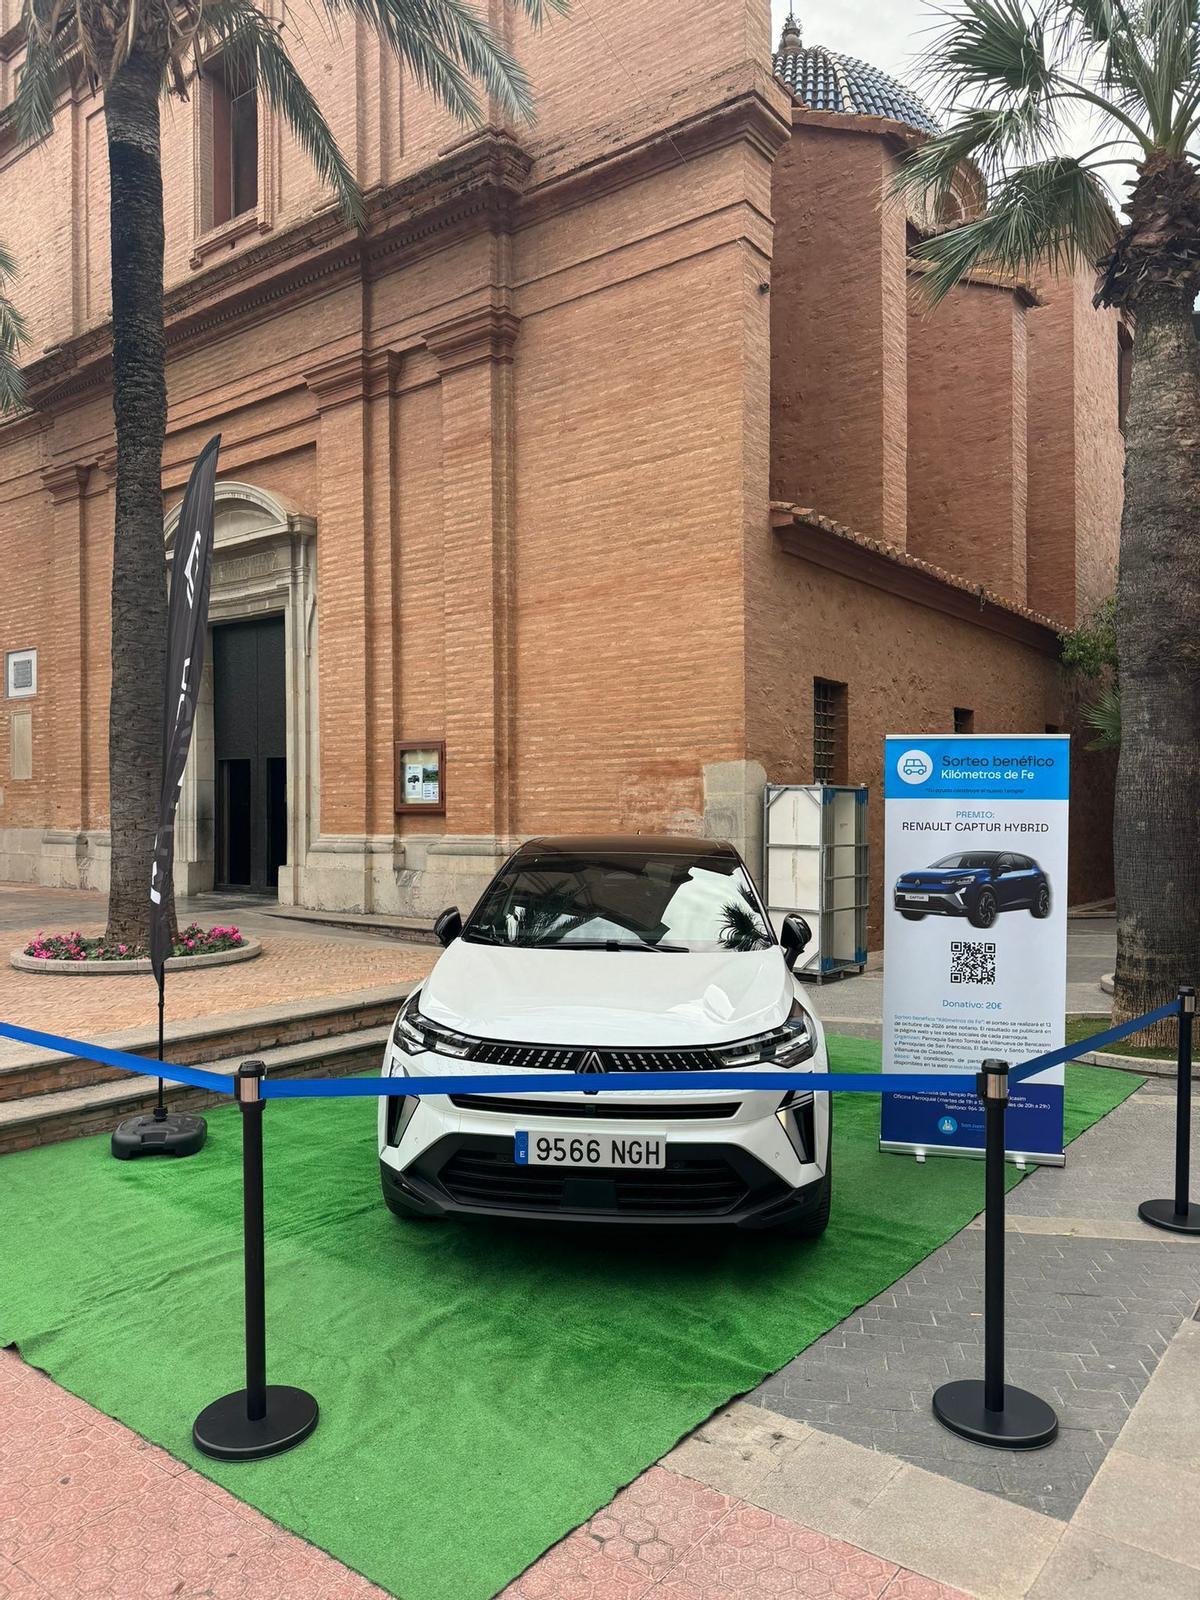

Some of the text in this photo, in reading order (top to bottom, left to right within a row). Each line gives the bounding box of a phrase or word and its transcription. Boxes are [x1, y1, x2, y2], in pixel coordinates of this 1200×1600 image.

[942, 756, 1055, 768] Sorteo benéfico
[941, 769, 1034, 780] Kilómetros de Fe
[956, 811, 996, 819] PREMIO:
[902, 822, 1050, 833] RENAULT CAPTUR HYBRID
[942, 999, 1002, 1010] Donativo: 20€
[519, 1150, 526, 1158] E
[536, 1137, 660, 1165] 9566 NGH
